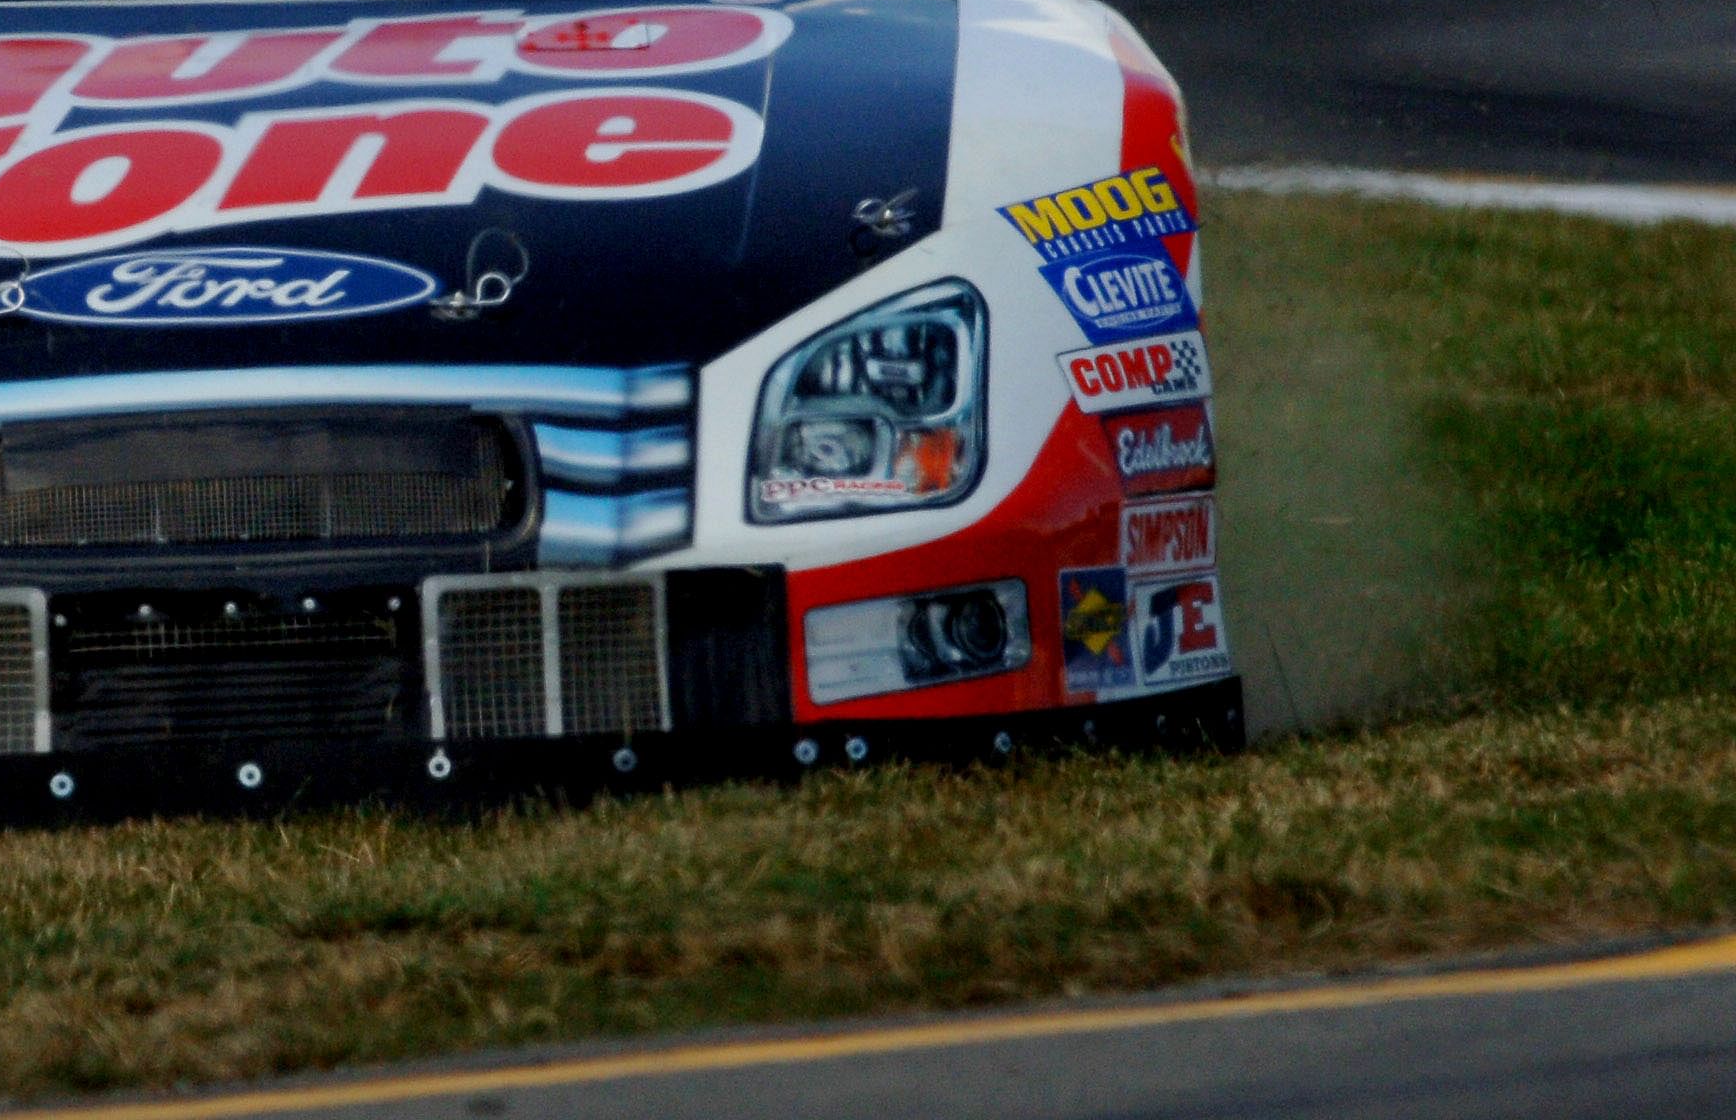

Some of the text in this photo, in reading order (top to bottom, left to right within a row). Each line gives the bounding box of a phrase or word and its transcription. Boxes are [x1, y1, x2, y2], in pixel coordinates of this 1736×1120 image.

[1007, 166, 1178, 244] MOOG
[86, 257, 352, 313] Ford
[1070, 344, 1173, 397] COMP
[1126, 505, 1209, 567] SIMPSON
[1143, 582, 1217, 675] JE
